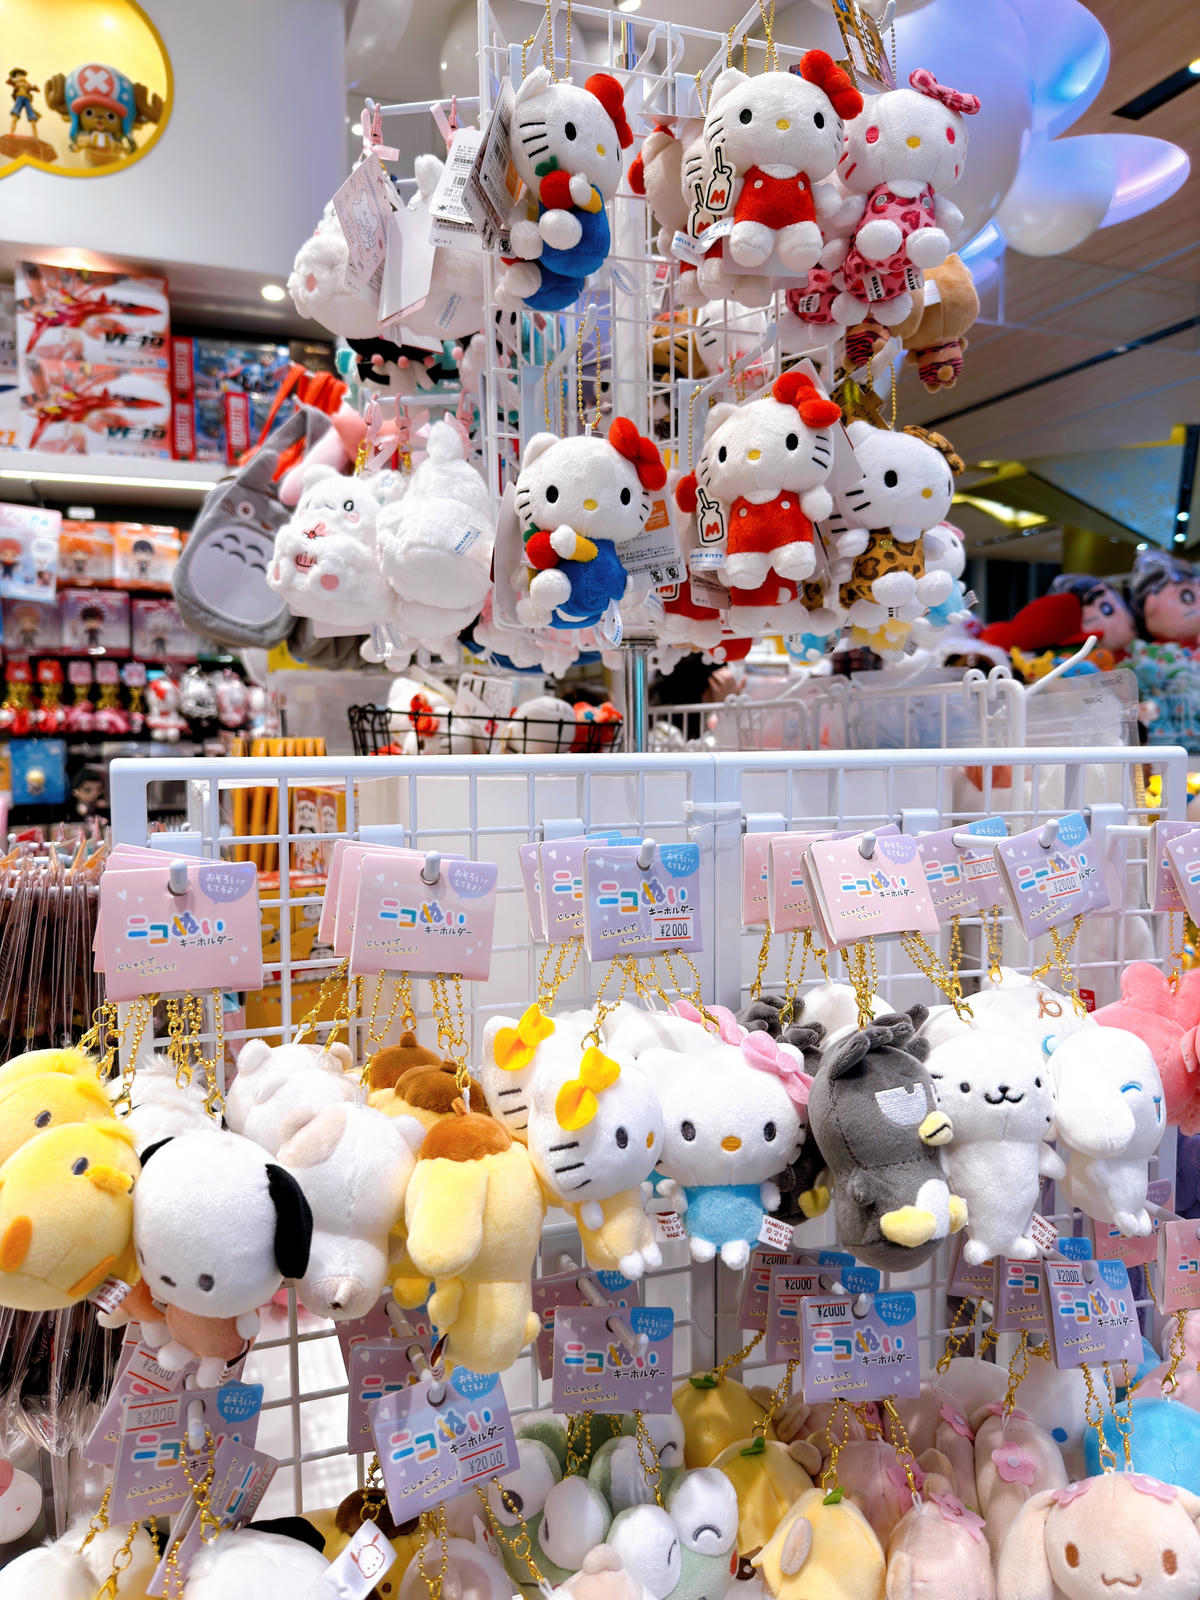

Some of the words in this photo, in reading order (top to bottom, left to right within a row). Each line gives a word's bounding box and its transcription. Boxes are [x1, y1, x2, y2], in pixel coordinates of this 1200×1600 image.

[906, 267, 916, 291] KITTY
[871, 275, 883, 299] HELLO
[840, 870, 906, 896] ニコぬい
[1052, 876, 1077, 893] ¥2000
[598, 878, 688, 913] ニコぬい
[879, 889, 916, 898] キーホルダー
[379, 900, 466, 928] ニコぬい
[648, 906, 695, 916] キーホルダー
[127, 911, 224, 945] ニコぬい
[424, 926, 473, 936] キーホルダー
[601, 922, 638, 937] じしゃくで
[659, 923, 688, 937] ¥2000
[179, 935, 235, 948] キーホルダー
[366, 938, 401, 947] じしゃくで
[117, 957, 155, 971] じしゃくで
[764, 1218, 785, 1232] SANRIO
[767, 1236, 783, 1246] MADE
[761, 1254, 788, 1265] ¥2000
[1056, 1269, 1080, 1283] ¥2000
[785, 1278, 813, 1291] ¥2000
[817, 1304, 846, 1318] ¥2000
[1007, 1302, 1037, 1313] じしゃくで
[1059, 1290, 1127, 1323] ニコぬい
[1096, 1317, 1135, 1328] キーホルダー
[813, 1328, 903, 1360] ニコぬい
[1063, 1332, 1092, 1345] じしゃくで
[564, 1343, 657, 1373] ニコぬい
[862, 1354, 913, 1366] キーホルダー
[613, 1369, 667, 1379] キーホルダー
[816, 1371, 850, 1382] じしゃくで
[565, 1383, 600, 1394] じしゃくで
[136, 1406, 174, 1425] ¥2000
[391, 1409, 493, 1462] ニコぬい
[449, 1426, 505, 1455] キーホルダー
[468, 1450, 503, 1474] ¥2000
[130, 1478, 173, 1497] じしゃくで
[402, 1467, 440, 1495] じしゃくで
